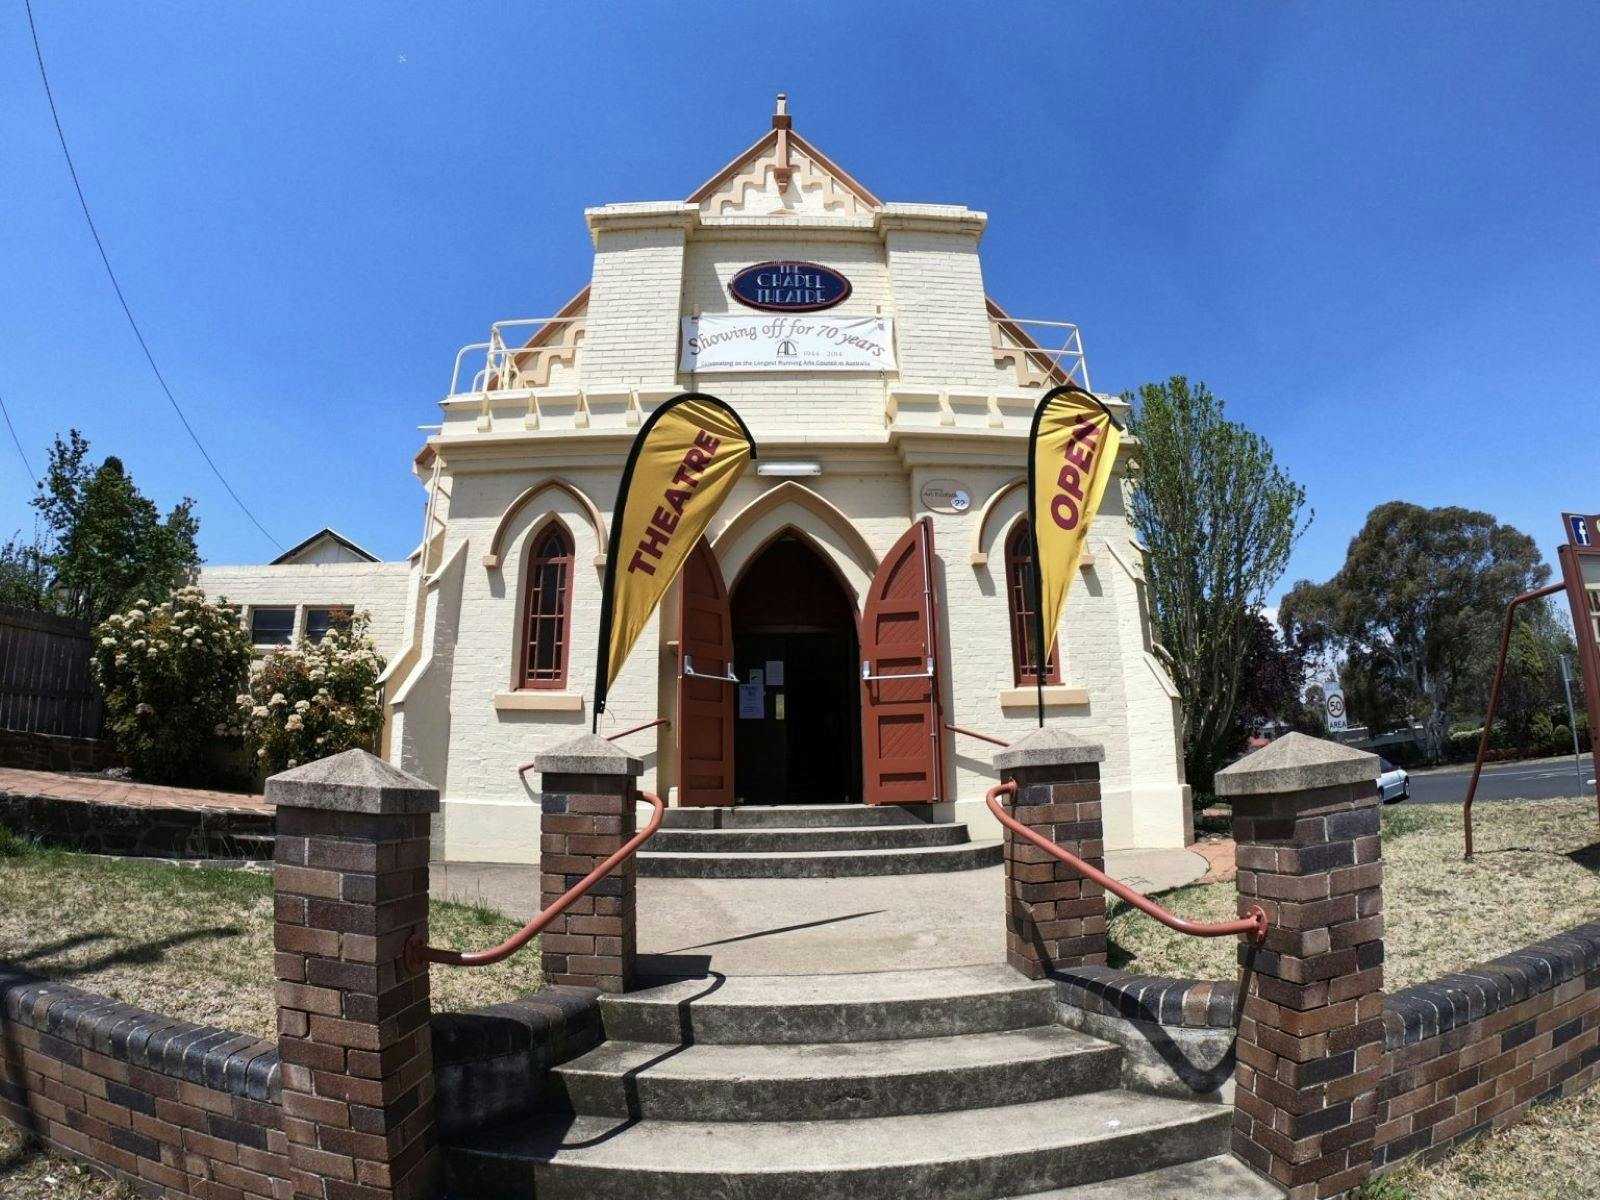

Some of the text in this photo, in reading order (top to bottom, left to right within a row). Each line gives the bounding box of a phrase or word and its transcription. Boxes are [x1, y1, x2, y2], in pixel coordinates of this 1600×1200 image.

[780, 264, 799, 274] THE
[756, 273, 825, 288] CHAPEL
[757, 288, 826, 303] THEATRE
[688, 325, 758, 356] Showing
[761, 317, 787, 338] off
[785, 318, 815, 338] for
[817, 324, 839, 339] 70
[834, 331, 885, 357] years
[1051, 413, 1100, 530] OPEN
[627, 429, 721, 576] THEATRE
[1329, 701, 1342, 712] 50
[1329, 720, 1347, 729] AREA
